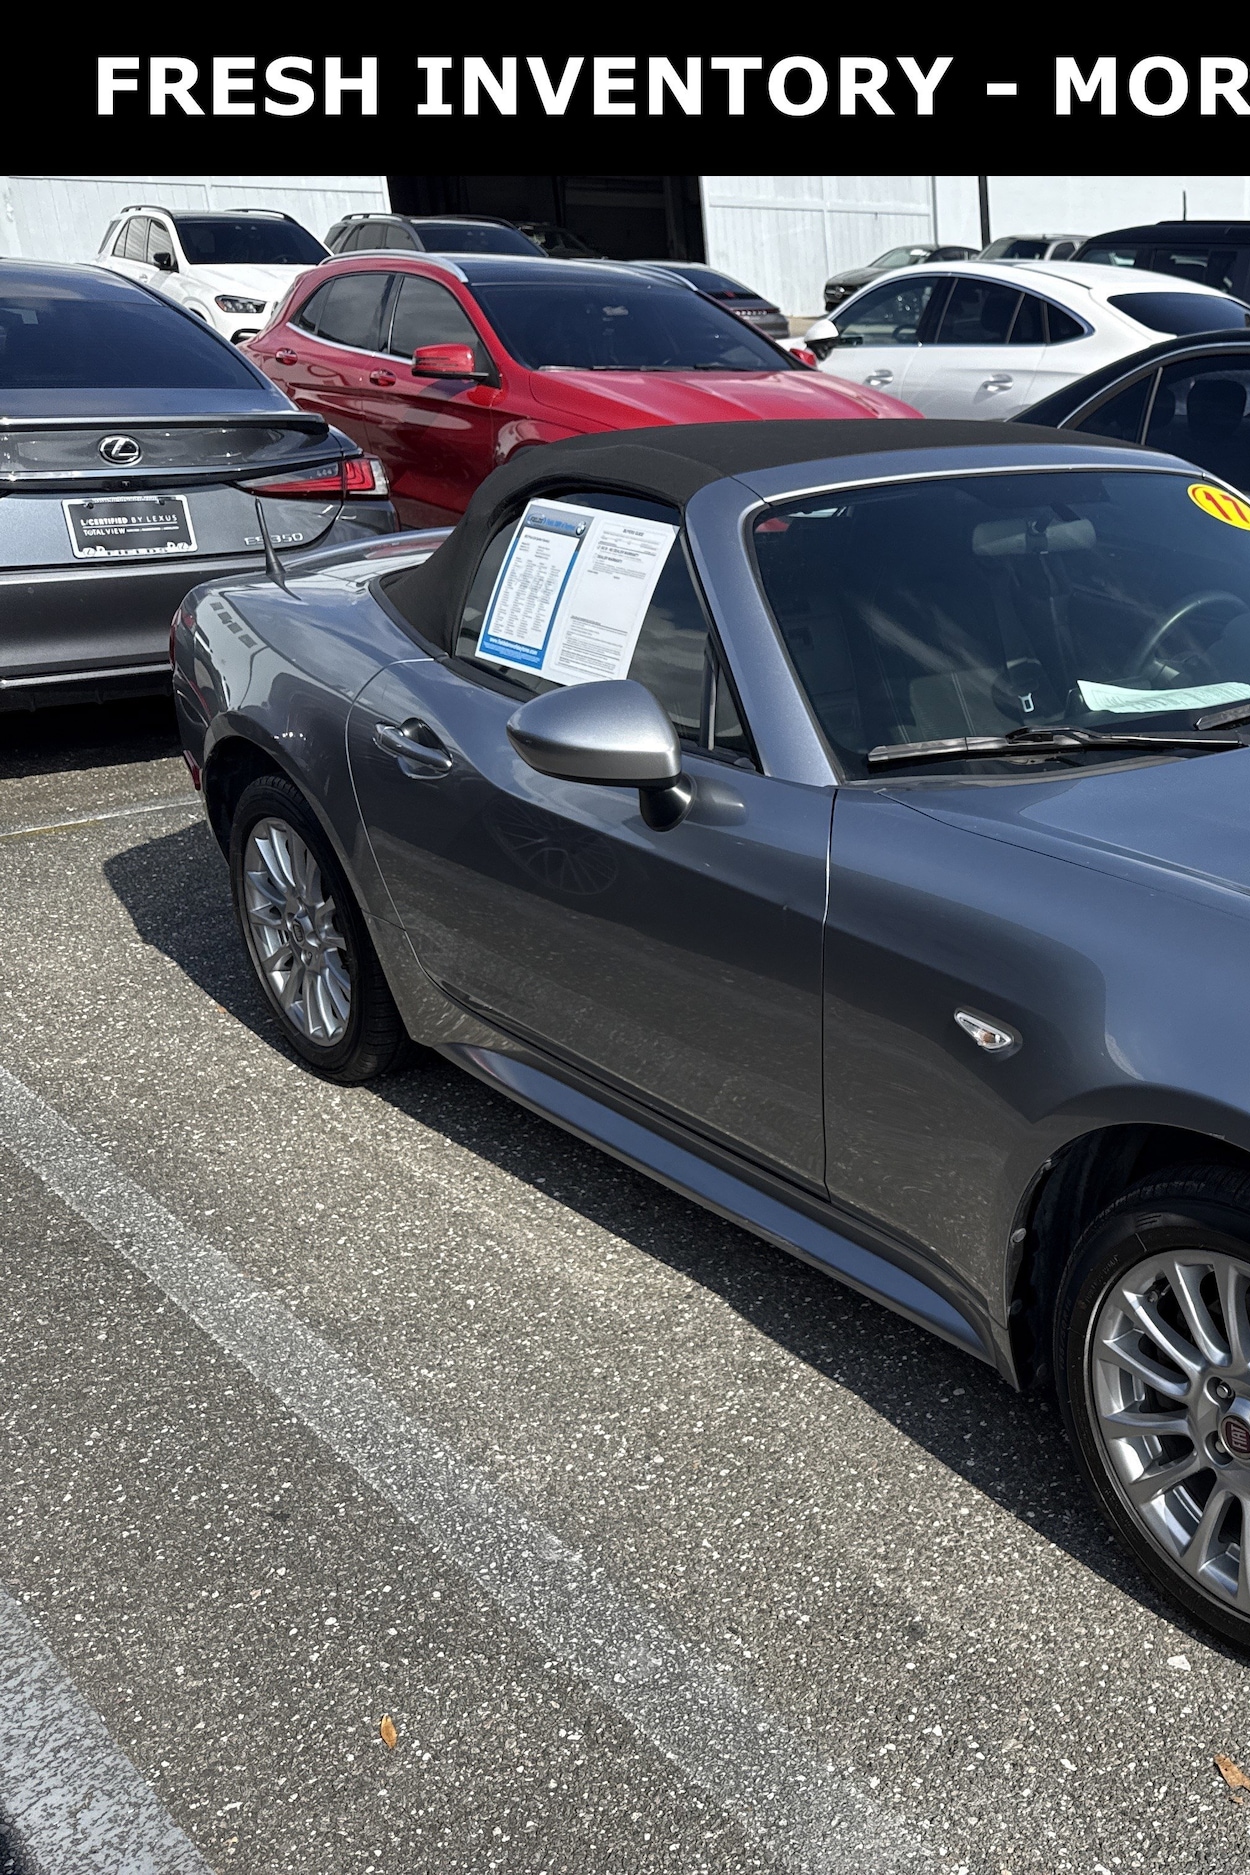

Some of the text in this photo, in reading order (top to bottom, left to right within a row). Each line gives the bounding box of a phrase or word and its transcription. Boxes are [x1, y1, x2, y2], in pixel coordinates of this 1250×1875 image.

[131, 516, 143, 524] BY
[146, 514, 178, 523] LEXUS
[1203, 489, 1250, 525] 17
[1230, 1423, 1248, 1452] FIAT
